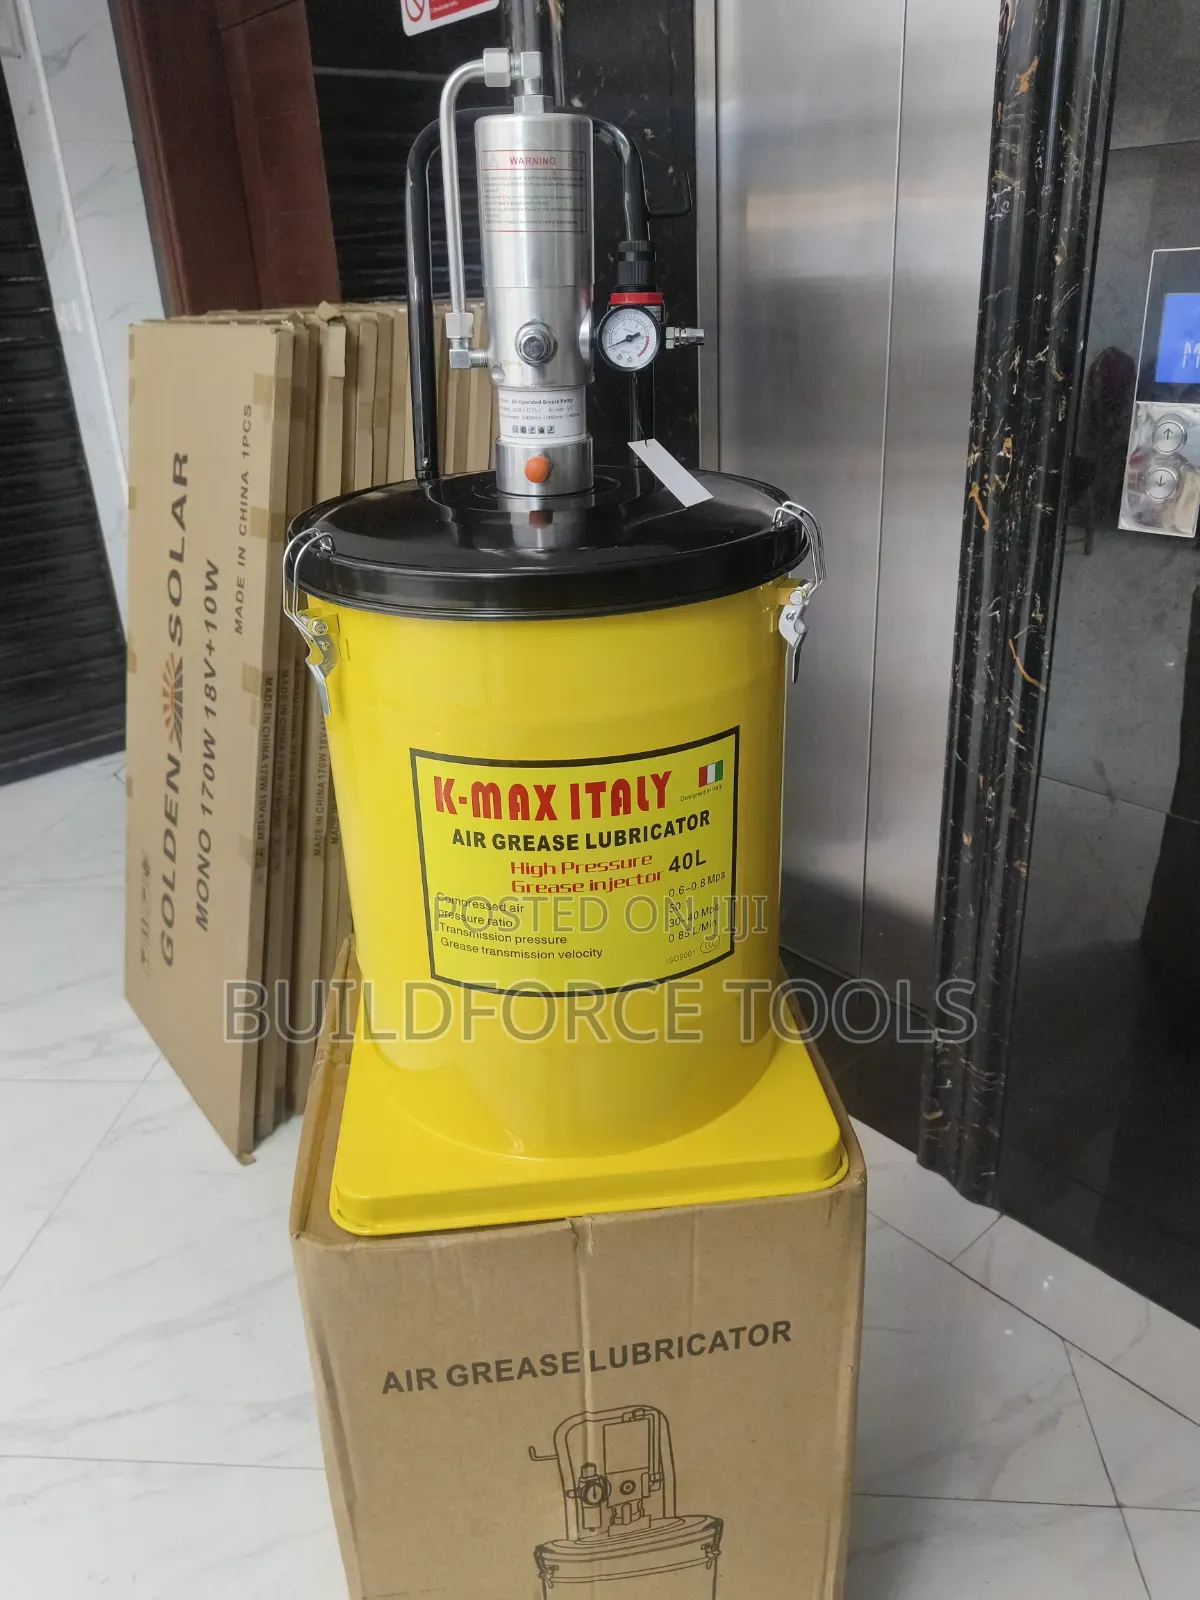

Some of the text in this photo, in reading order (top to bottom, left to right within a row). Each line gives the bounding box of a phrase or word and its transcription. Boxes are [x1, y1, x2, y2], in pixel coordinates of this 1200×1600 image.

[509, 156, 556, 166] WARNING
[234, 404, 252, 635] MADE IN CHINA 1PCS
[263, 677, 274, 709] MADE
[161, 451, 188, 967] GOLDEN SOLAR
[262, 712, 272, 724] IN
[196, 558, 220, 932] MONO 170W 18V+10W
[261, 726, 271, 761] CHINA
[318, 752, 326, 780] 170W
[316, 781, 326, 814] CHINA
[433, 770, 673, 821] K-MAX ITALY
[680, 790, 706, 802] Designed
[316, 815, 324, 825] IN
[452, 808, 711, 852] AIR GREASE LUBRICATOR
[314, 825, 322, 857] MADE
[510, 854, 653, 878] High Pressure
[668, 849, 707, 873] 40L
[511, 870, 664, 894] Grease injector
[708, 871, 726, 884] Mpa
[436, 892, 525, 914] Compressed air
[701, 903, 720, 917] Mpa
[438, 908, 513, 928] pressure ratio
[439, 921, 568, 946] Transmission pressure
[668, 919, 717, 943] 0.85 L/Min
[440, 936, 603, 960] Grease transmission velocity
[666, 949, 696, 964] ISO9001
[382, 1320, 792, 1394] AIR GREASE LUBRICATOR
